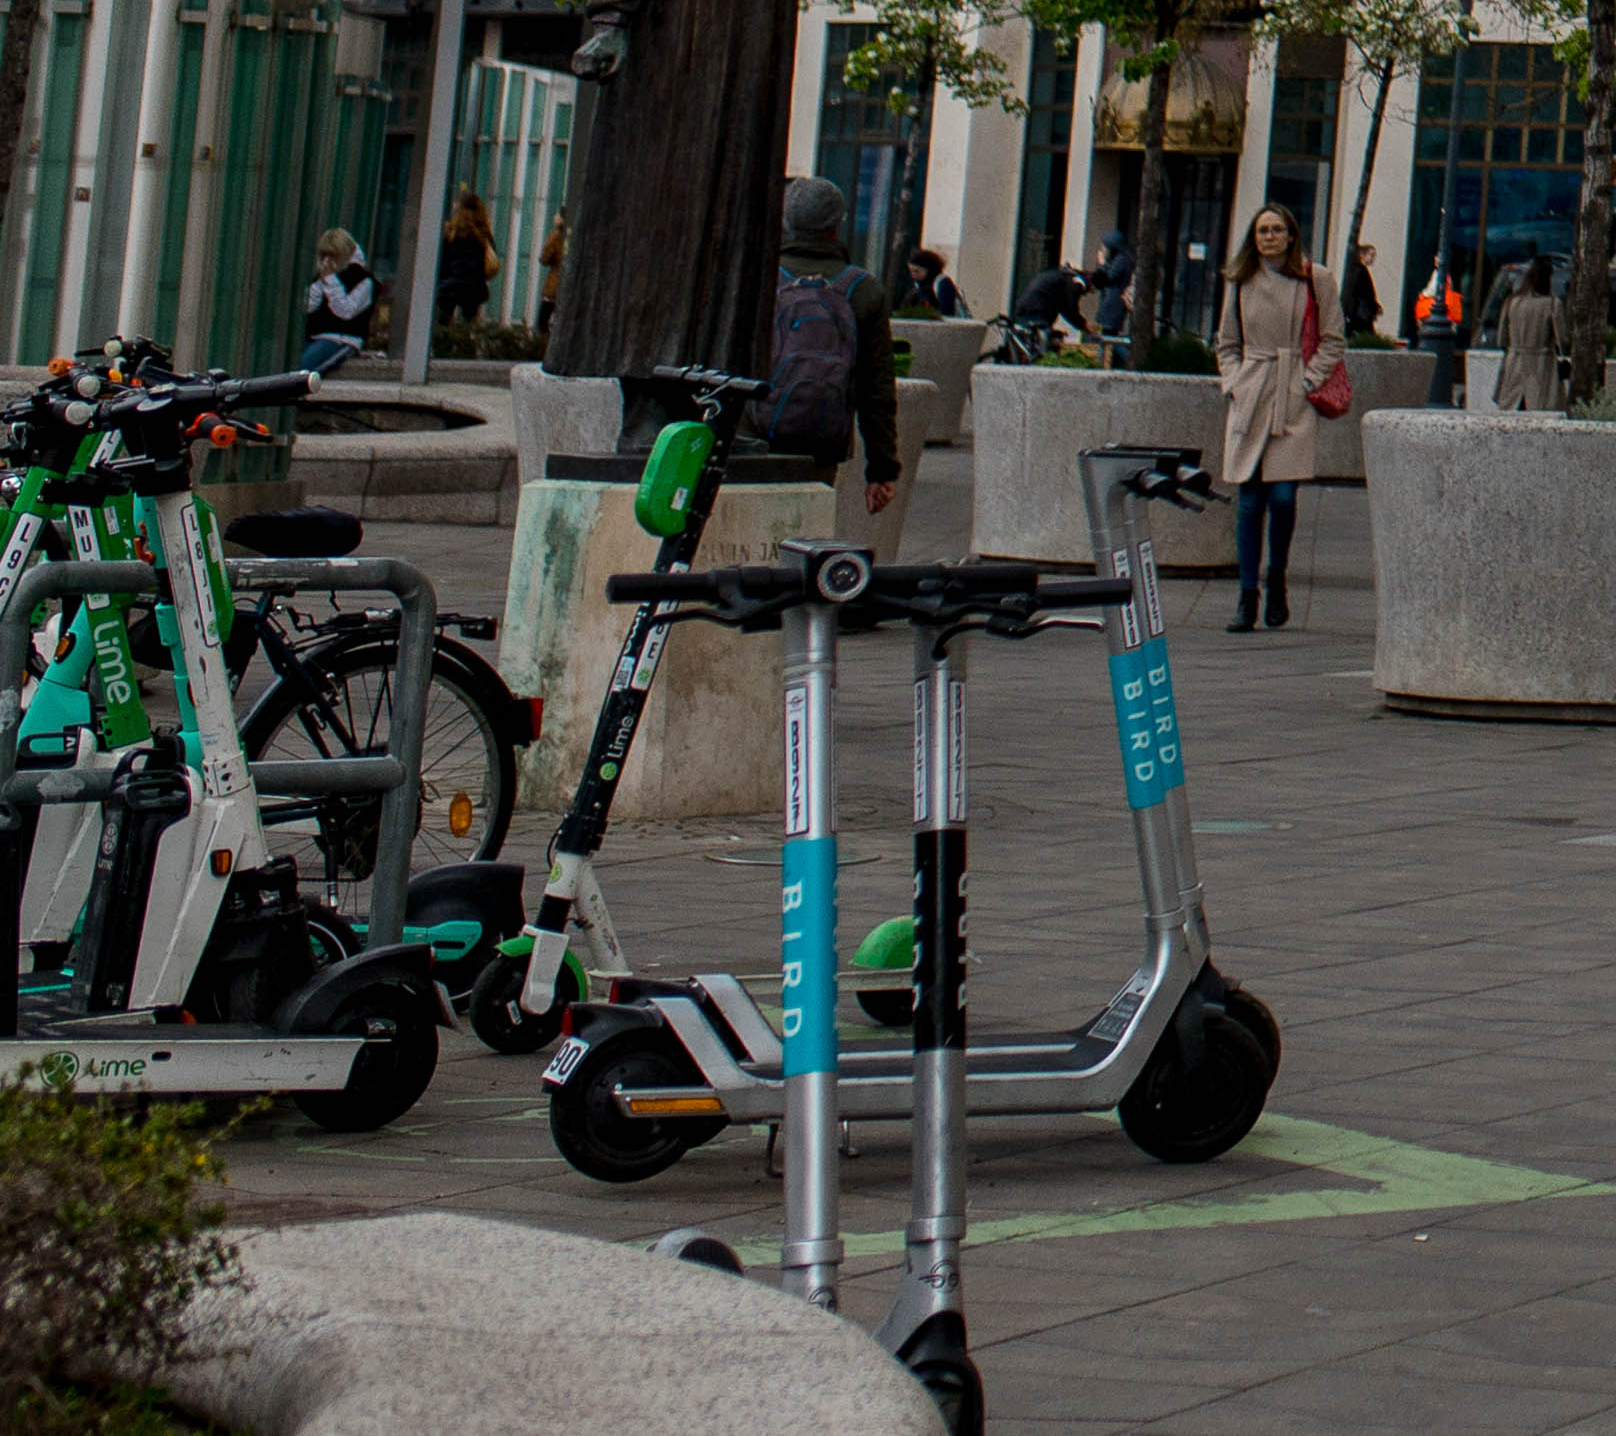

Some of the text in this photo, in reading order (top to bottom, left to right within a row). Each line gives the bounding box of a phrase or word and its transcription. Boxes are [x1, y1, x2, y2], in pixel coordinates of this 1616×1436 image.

[93, 620, 131, 705] Lime
[606, 714, 636, 761] Lime
[1123, 677, 1154, 782] BIRD
[1148, 663, 1177, 764] BIRD
[782, 879, 803, 1038] BIRD
[90, 1057, 147, 1078] Lime
